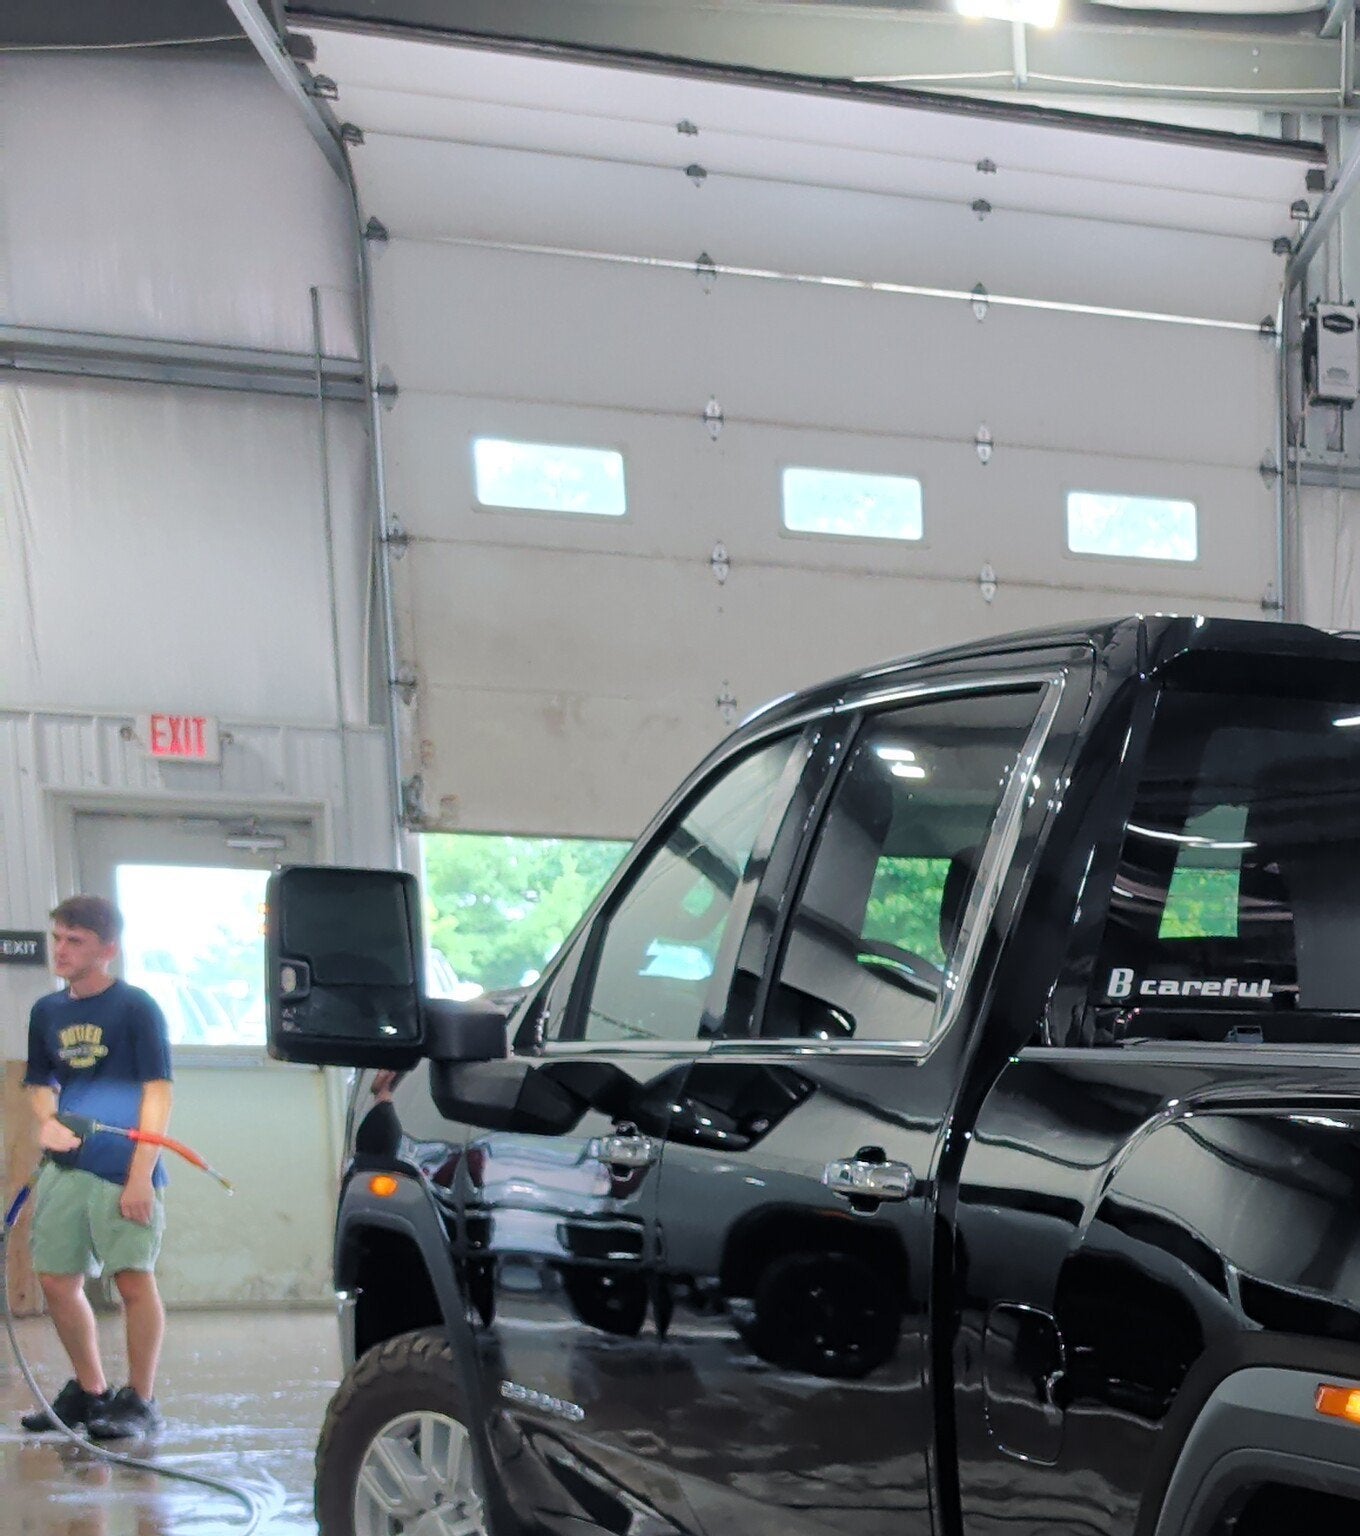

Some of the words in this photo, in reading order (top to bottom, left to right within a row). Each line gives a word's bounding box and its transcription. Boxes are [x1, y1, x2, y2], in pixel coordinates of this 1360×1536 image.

[150, 713, 208, 758] EXIT
[3, 939, 38, 956] EXIT
[1107, 967, 1135, 998] B
[1139, 978, 1274, 998] careful
